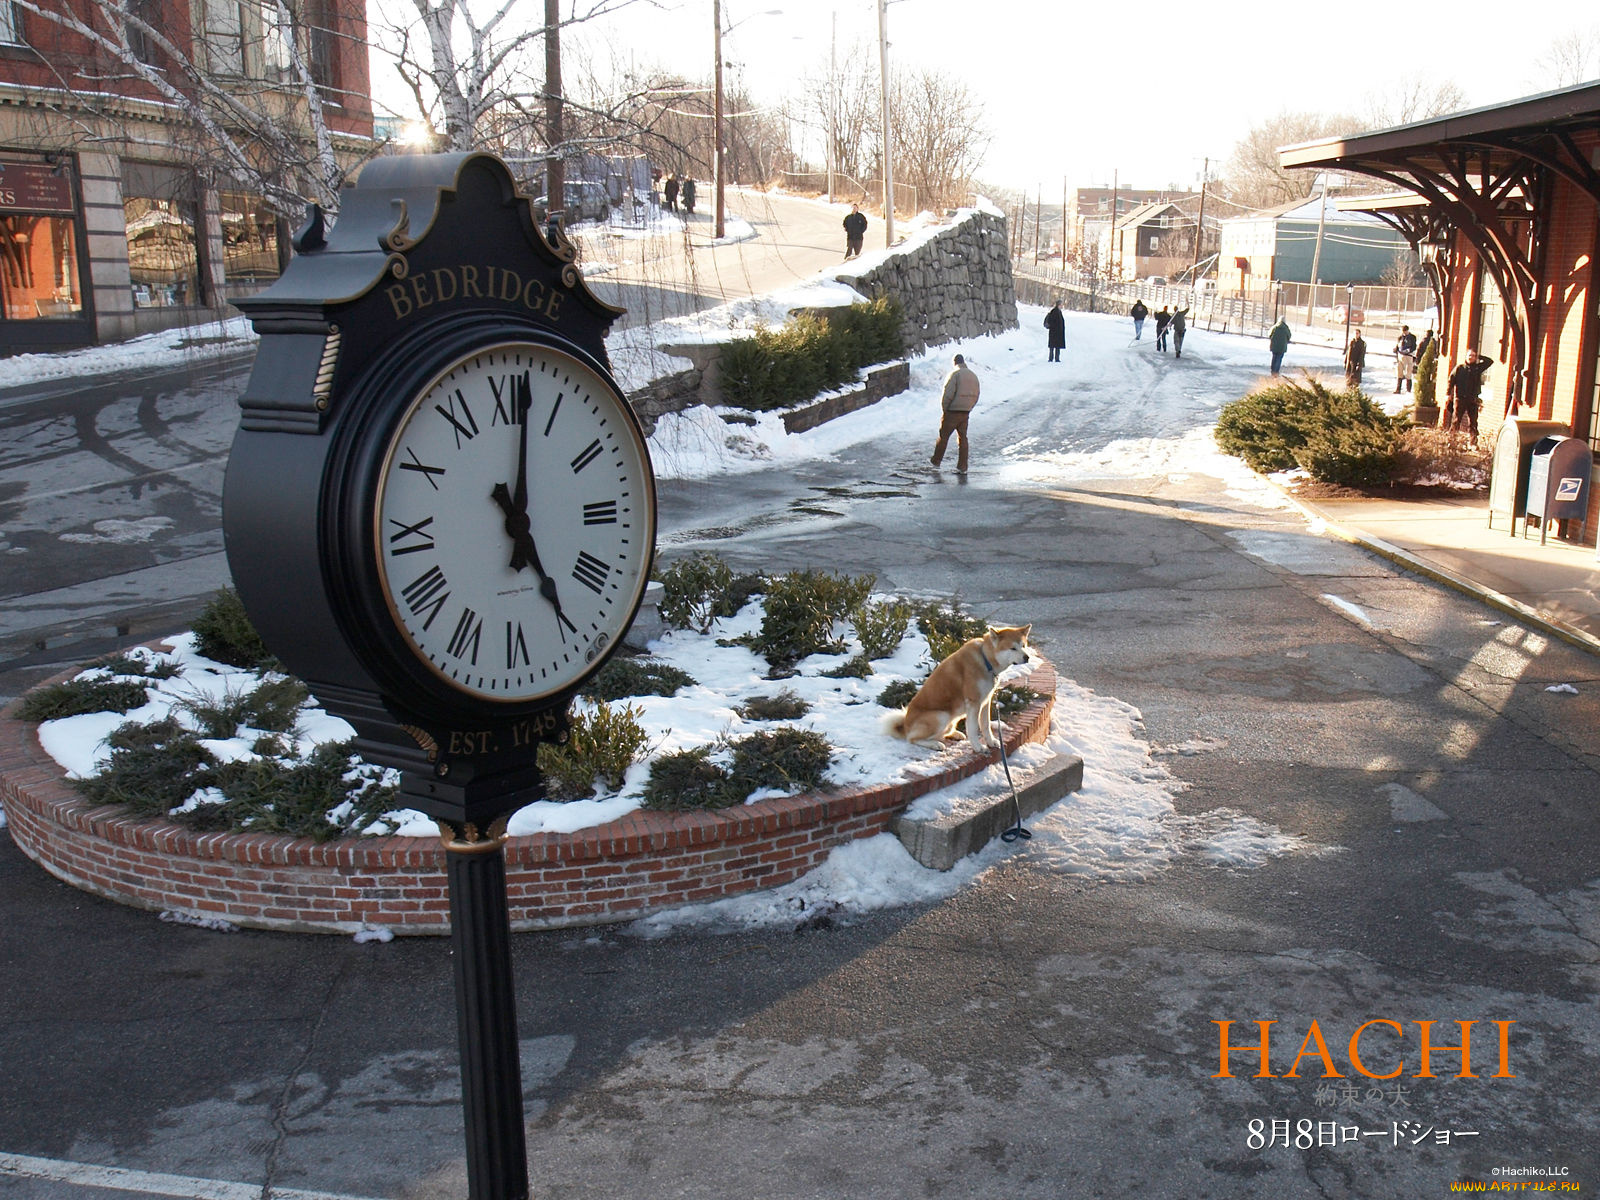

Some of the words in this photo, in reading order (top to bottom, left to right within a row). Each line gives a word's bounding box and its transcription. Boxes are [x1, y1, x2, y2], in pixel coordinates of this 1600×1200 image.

[385, 265, 564, 321] BEDRIDGE
[435, 389, 479, 450] XI
[399, 447, 446, 490] X
[389, 516, 434, 556] IX
[583, 500, 617, 525] III
[401, 565, 451, 631] VIII
[447, 607, 483, 666] VII
[507, 621, 530, 669] VI
[448, 731, 498, 755] EST.
[512, 709, 556, 747] 1748
